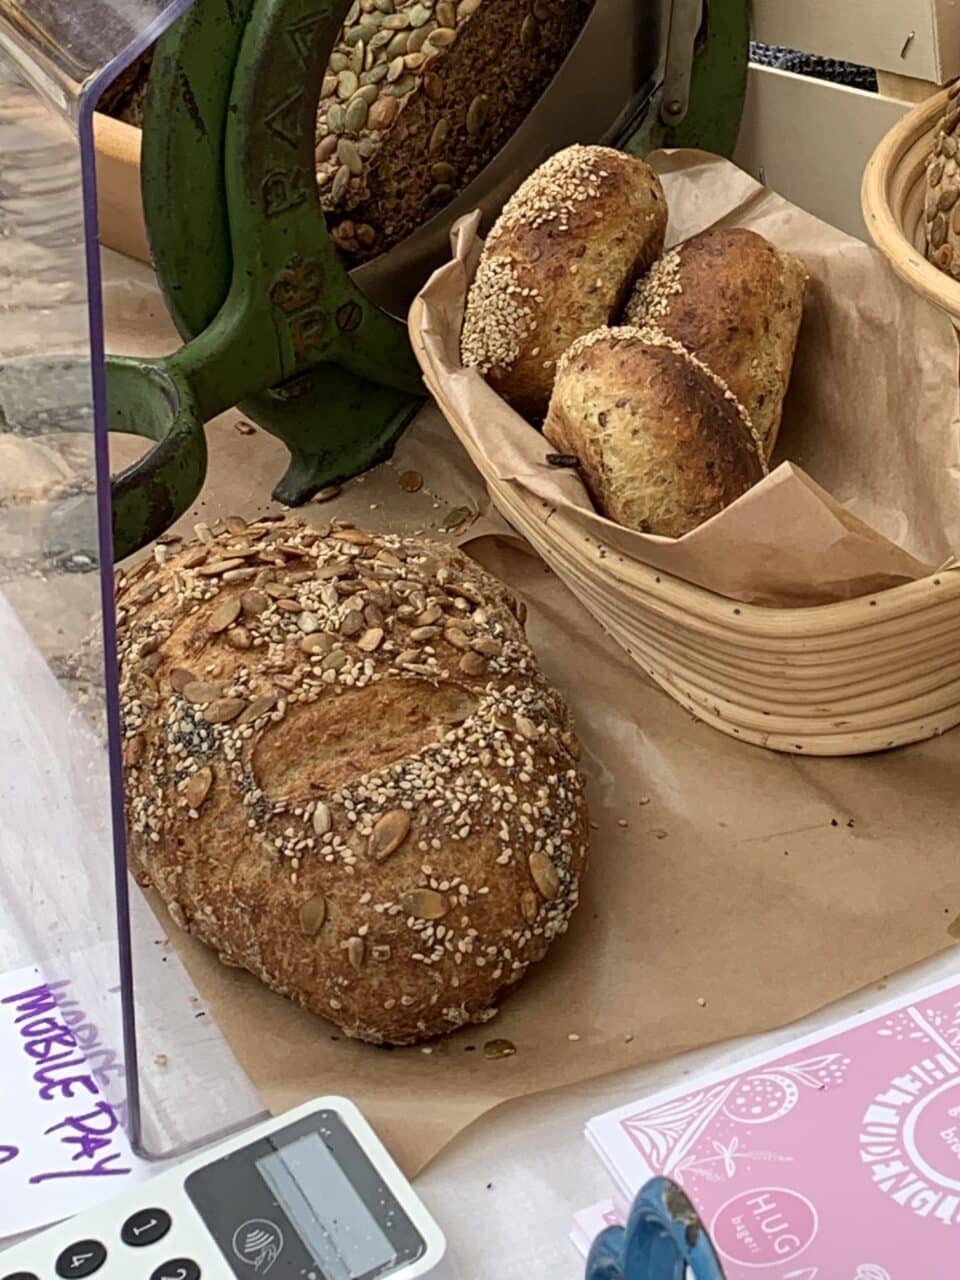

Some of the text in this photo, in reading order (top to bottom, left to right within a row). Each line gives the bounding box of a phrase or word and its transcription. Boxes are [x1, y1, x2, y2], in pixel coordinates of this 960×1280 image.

[1, 983, 99, 1100] MOBILE
[29, 1101, 132, 1184] PAY
[132, 1218, 158, 1237] 1
[745, 1193, 801, 1254] H.U.G
[70, 1252, 95, 1269] 4
